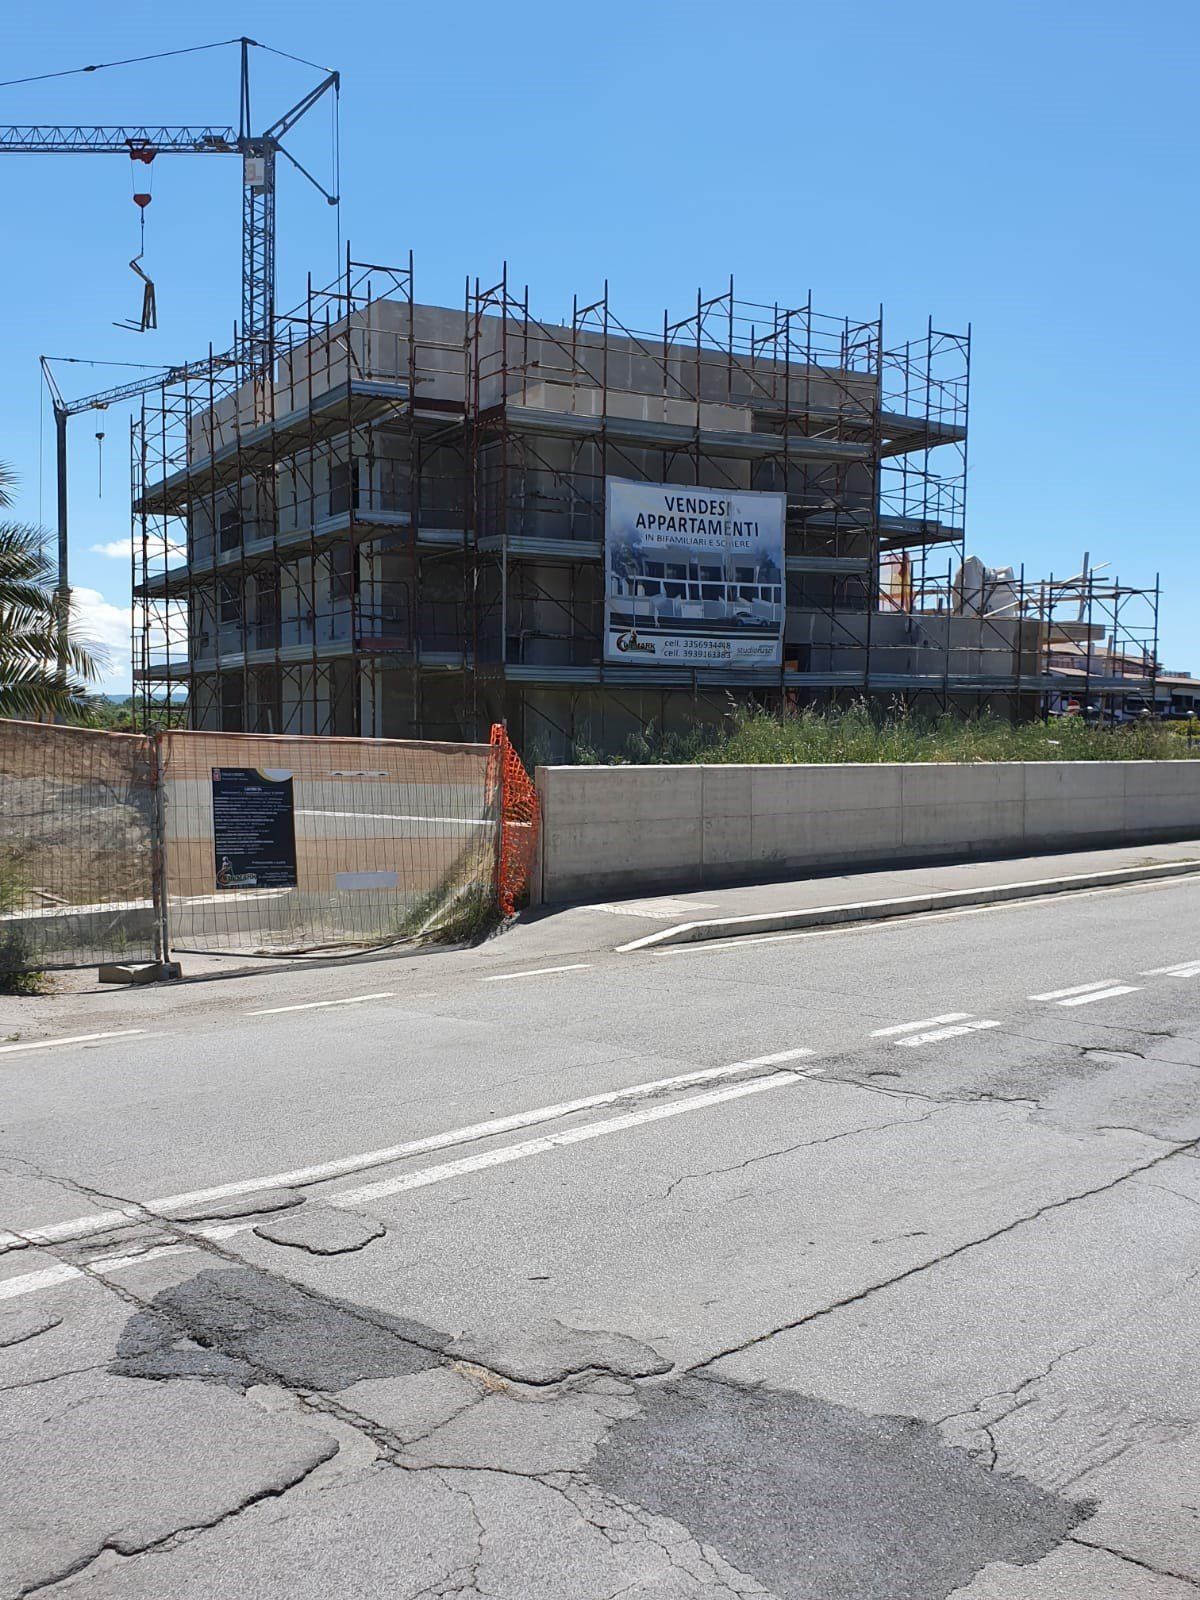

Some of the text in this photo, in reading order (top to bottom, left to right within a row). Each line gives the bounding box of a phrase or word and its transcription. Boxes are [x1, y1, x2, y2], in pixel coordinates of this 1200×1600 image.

[664, 495, 730, 516] VENDESI
[635, 512, 759, 537] APPARTAMENTI
[645, 533, 654, 541] IN
[656, 534, 707, 546] BIFAMILIARI
[664, 639, 681, 648] cell.
[663, 649, 680, 657] cell.
